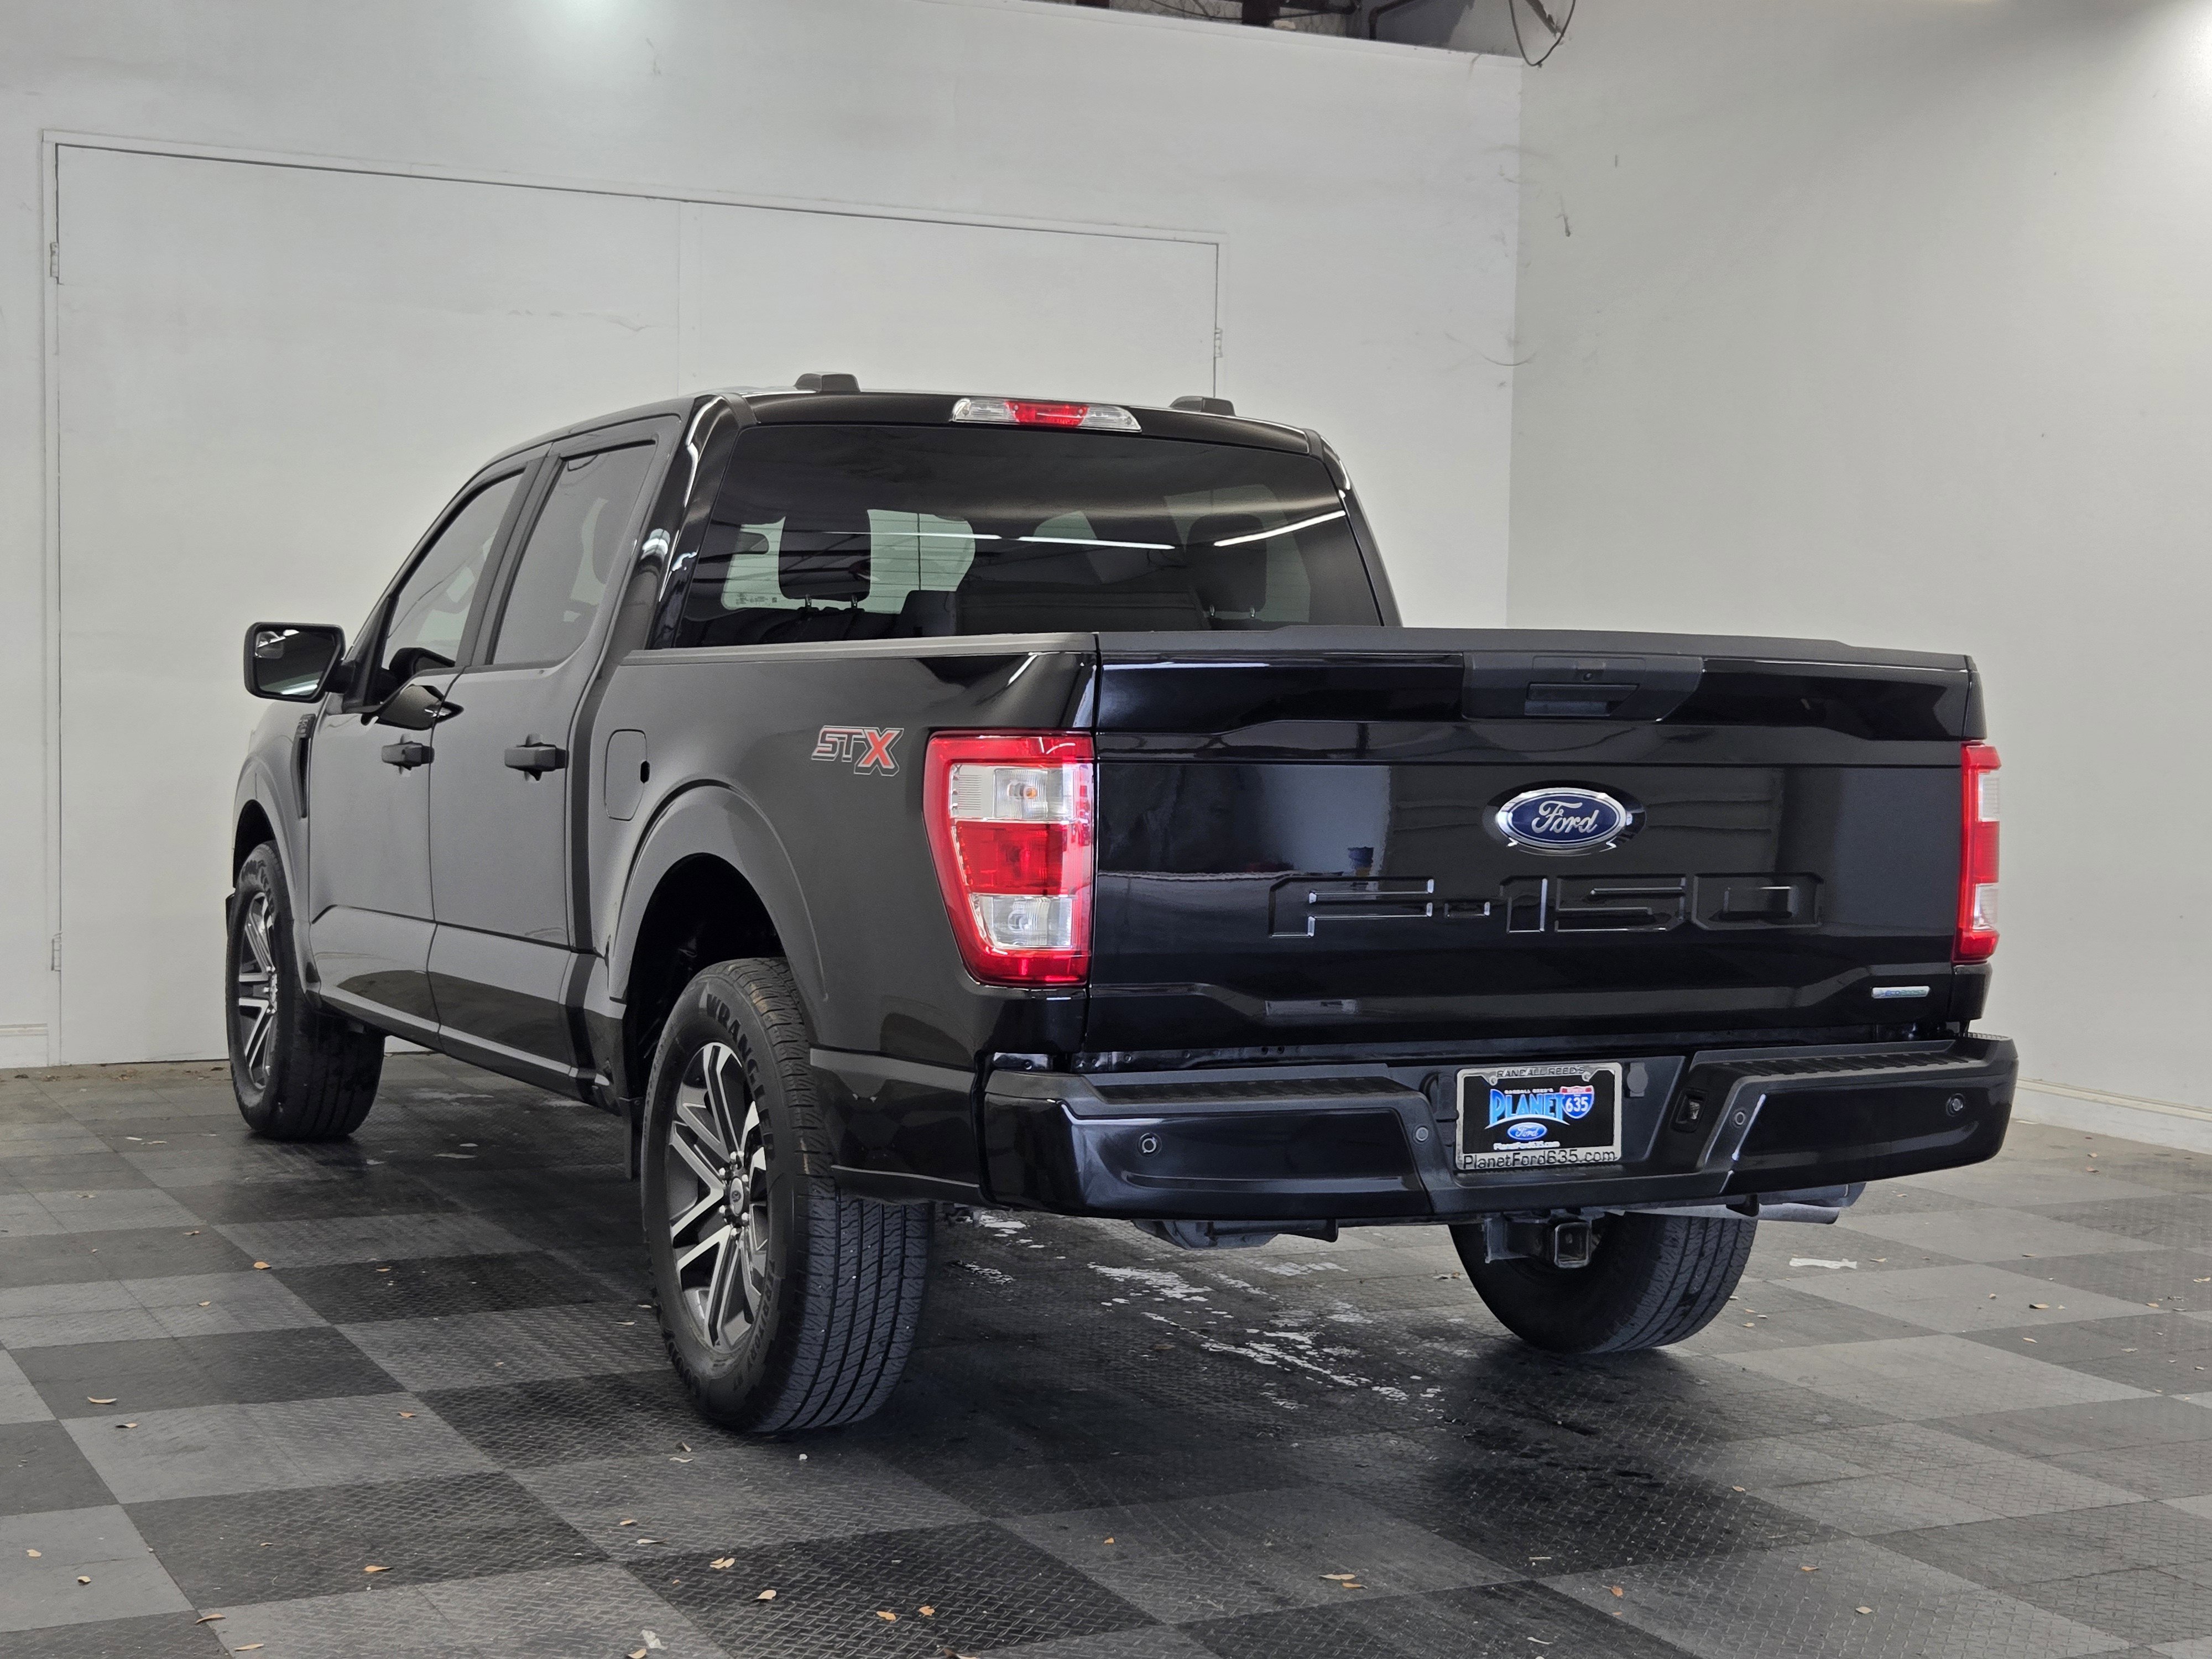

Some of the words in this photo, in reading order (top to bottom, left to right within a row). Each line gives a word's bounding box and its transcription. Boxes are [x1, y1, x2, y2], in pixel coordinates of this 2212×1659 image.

[811, 725, 904, 776] STX
[1531, 800, 1600, 833] Ford
[1269, 872, 1826, 938] F-150
[706, 993, 775, 1161] WRANGLER
[1496, 1069, 1545, 1078] RANDALL
[1548, 1066, 1585, 1075] REED'S
[1489, 1088, 1565, 1125] PLANET
[1565, 1095, 1589, 1114] 635
[1515, 1124, 1539, 1138] Ford
[1463, 1149, 1615, 1168] PlanetFord635.com
